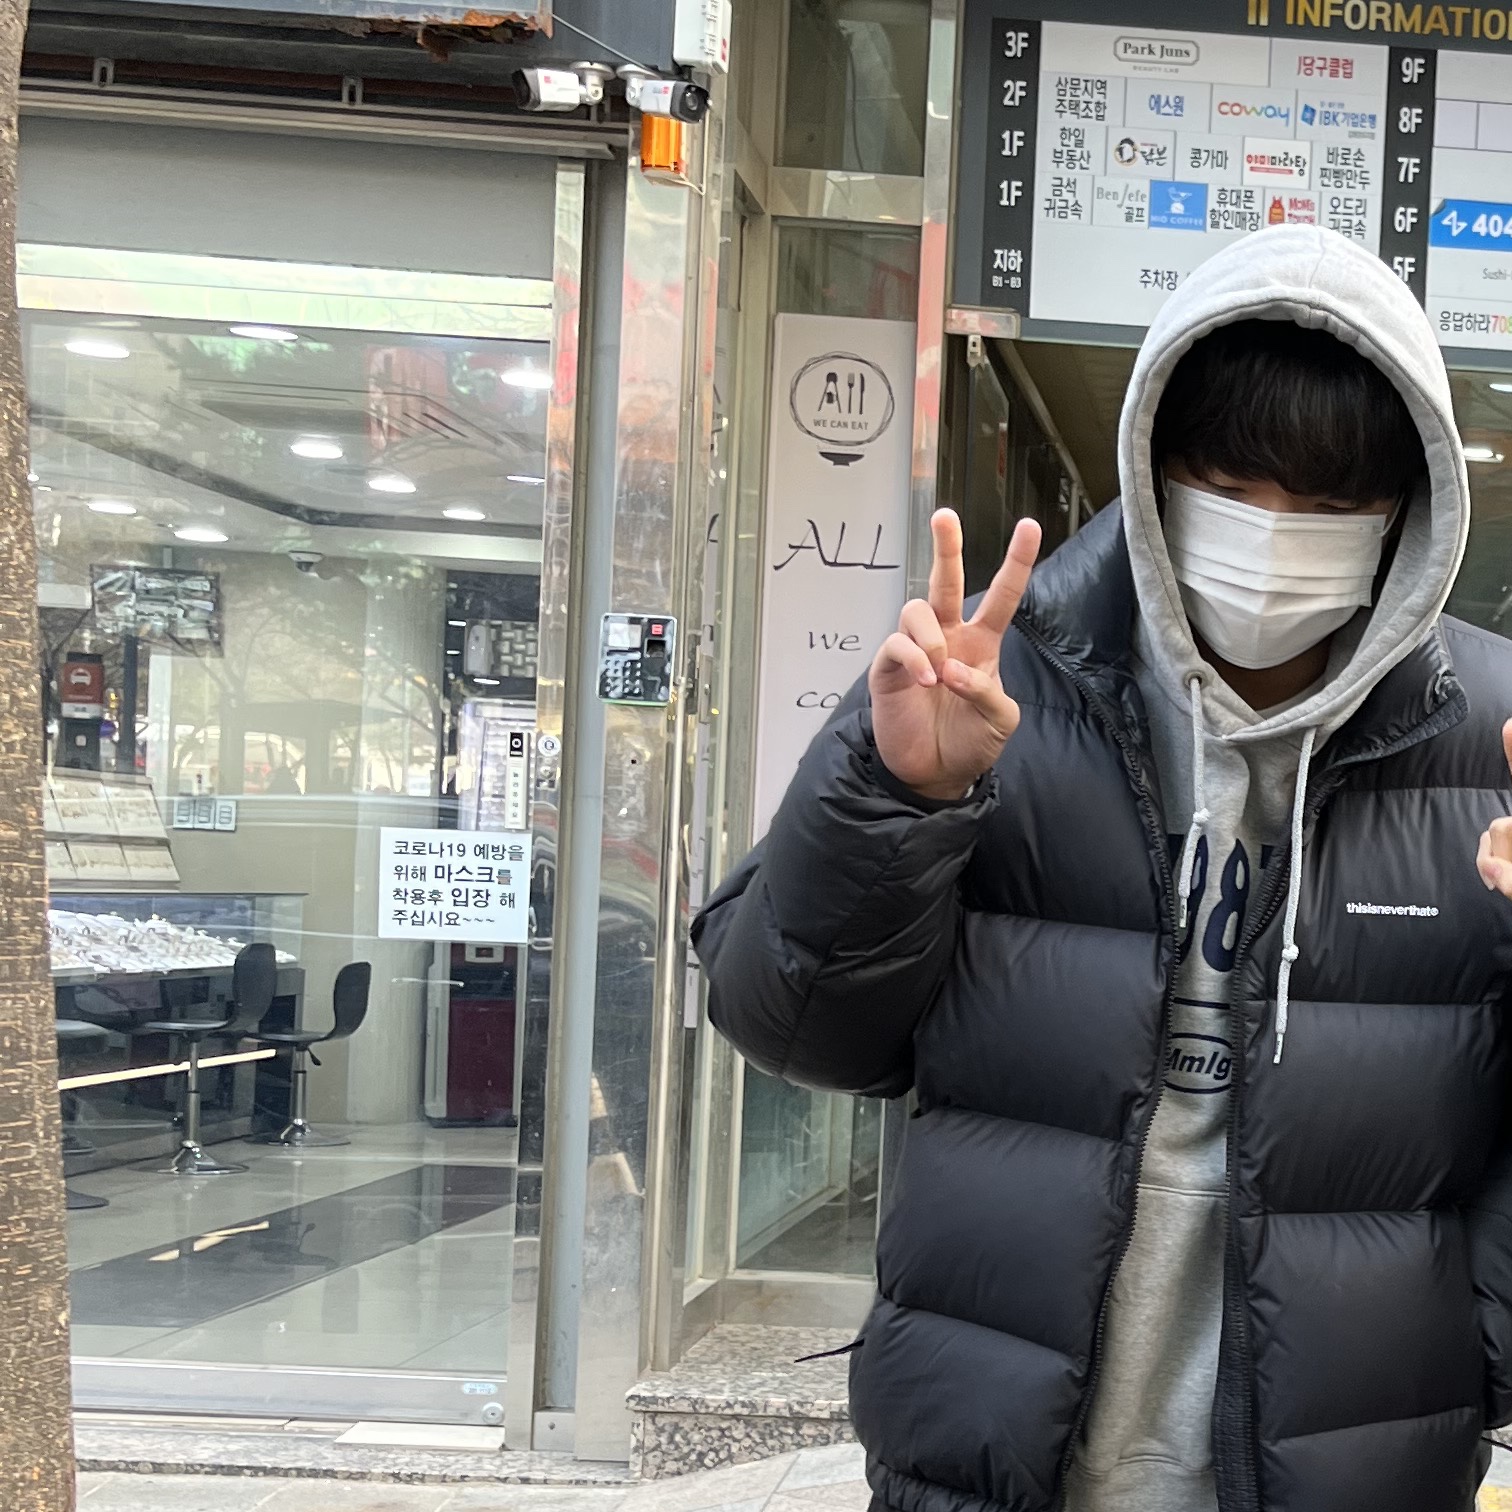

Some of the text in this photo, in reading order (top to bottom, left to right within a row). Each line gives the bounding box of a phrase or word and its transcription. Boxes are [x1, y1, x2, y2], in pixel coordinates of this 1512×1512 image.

[1004, 31, 1029, 57] 3F
[1122, 42, 1190, 58] Park Juns
[1401, 57, 1425, 84] 9F
[1002, 80, 1027, 106] 2F
[1055, 76, 1108, 99] 삼문지역
[1054, 98, 1107, 122] 주택조합
[1148, 94, 1185, 117] 에스원
[1218, 101, 1290, 128] coway
[1398, 108, 1423, 134] 8F
[1001, 130, 1025, 156] 1F
[1060, 126, 1085, 148] 한일
[1052, 148, 1091, 170] 부동산
[1190, 148, 1229, 170] 콩가마
[1326, 146, 1366, 168] 바로손
[1397, 157, 1420, 184] 7F
[999, 180, 1023, 206] 1F
[1052, 176, 1077, 198] 금석
[1044, 198, 1083, 220] 귀금속
[1216, 188, 1256, 210] 휴대폰
[1328, 196, 1366, 218] 오드리
[1124, 206, 1146, 223] 골프
[1209, 208, 1260, 232] 할인매장
[1394, 207, 1418, 234] 6F
[992, 249, 1023, 272] 지하
[1392, 256, 1416, 282] 5F
[1138, 269, 1179, 291] 주차장
[813, 418, 868, 430] WE CAN EAT
[772, 518, 900, 572] ALL
[808, 630, 862, 652] we
[393, 840, 524, 862] 코로나19 예방을
[393, 864, 512, 886] 위해 마스크를
[392, 888, 516, 909] 착용후 입장 해
